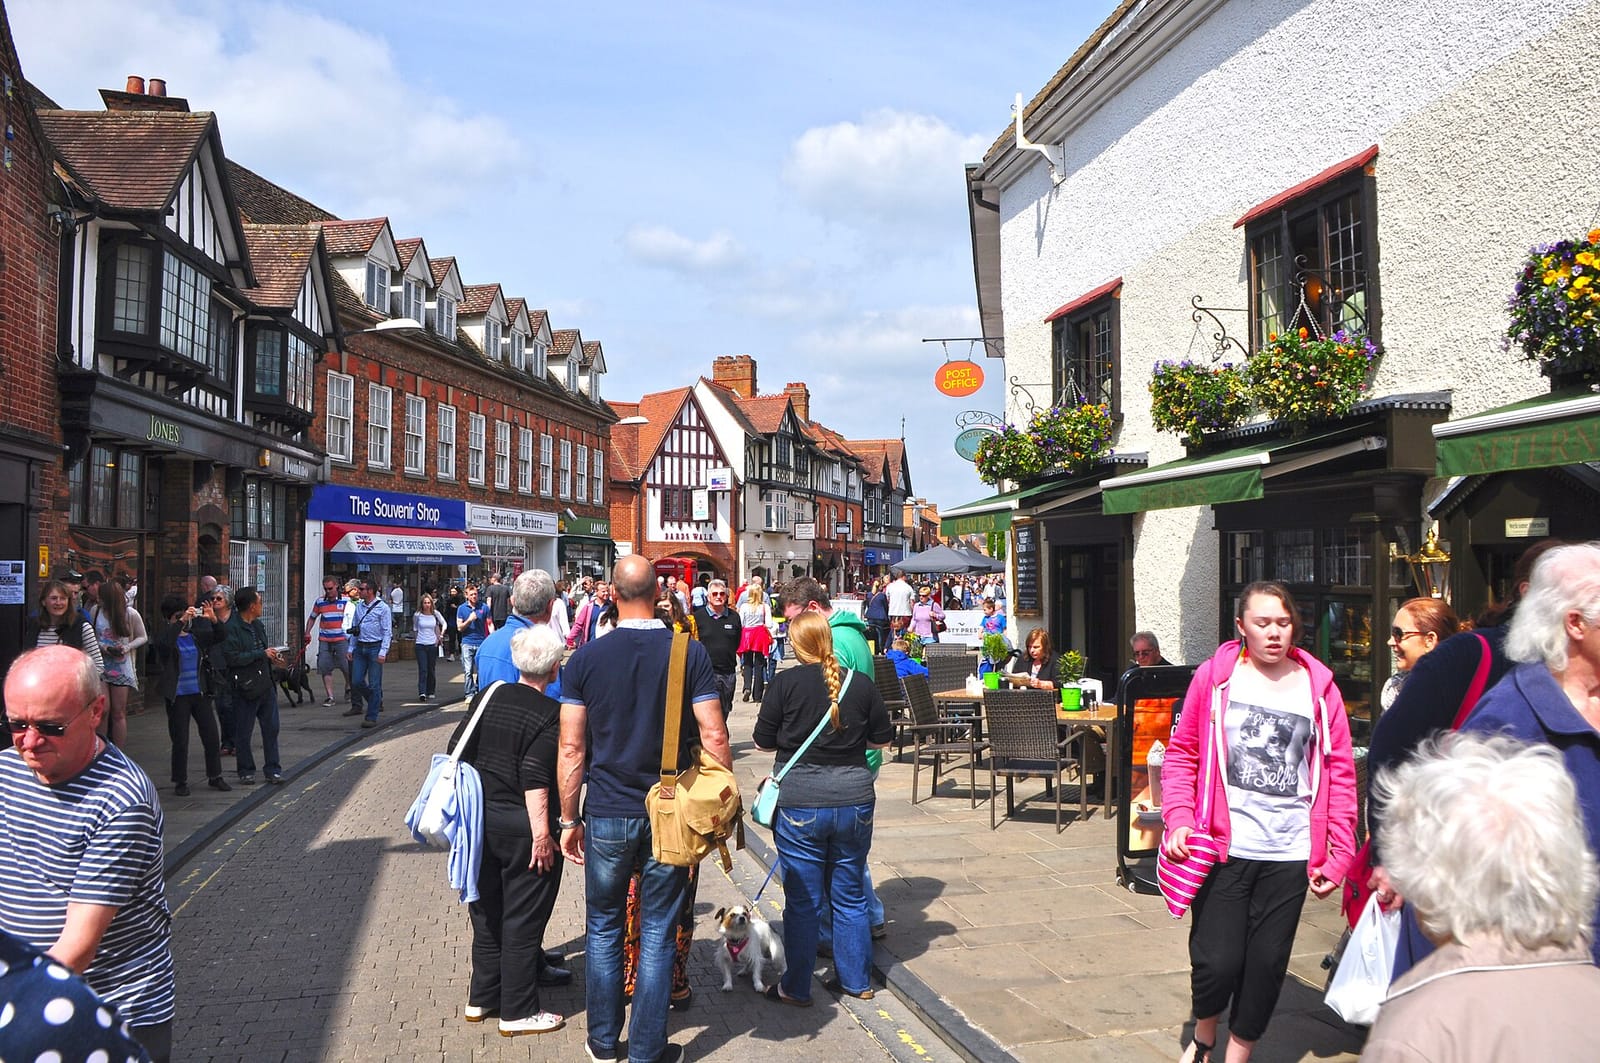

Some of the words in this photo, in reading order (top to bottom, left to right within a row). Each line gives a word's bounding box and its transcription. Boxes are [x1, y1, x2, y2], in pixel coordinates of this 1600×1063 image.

[946, 368, 971, 379] POST
[943, 378, 977, 389] OFFICE
[350, 496, 370, 516] The
[374, 498, 415, 519] Souvenir
[417, 503, 440, 526] Shop
[491, 510, 518, 530] Sporting
[521, 513, 543, 529] Barbers
[665, 533, 690, 541] BARDS
[693, 533, 713, 541] WALK
[387, 539, 405, 549] GREAT
[406, 540, 426, 550] BRITISH
[1239, 764, 1298, 792] #Selfie
